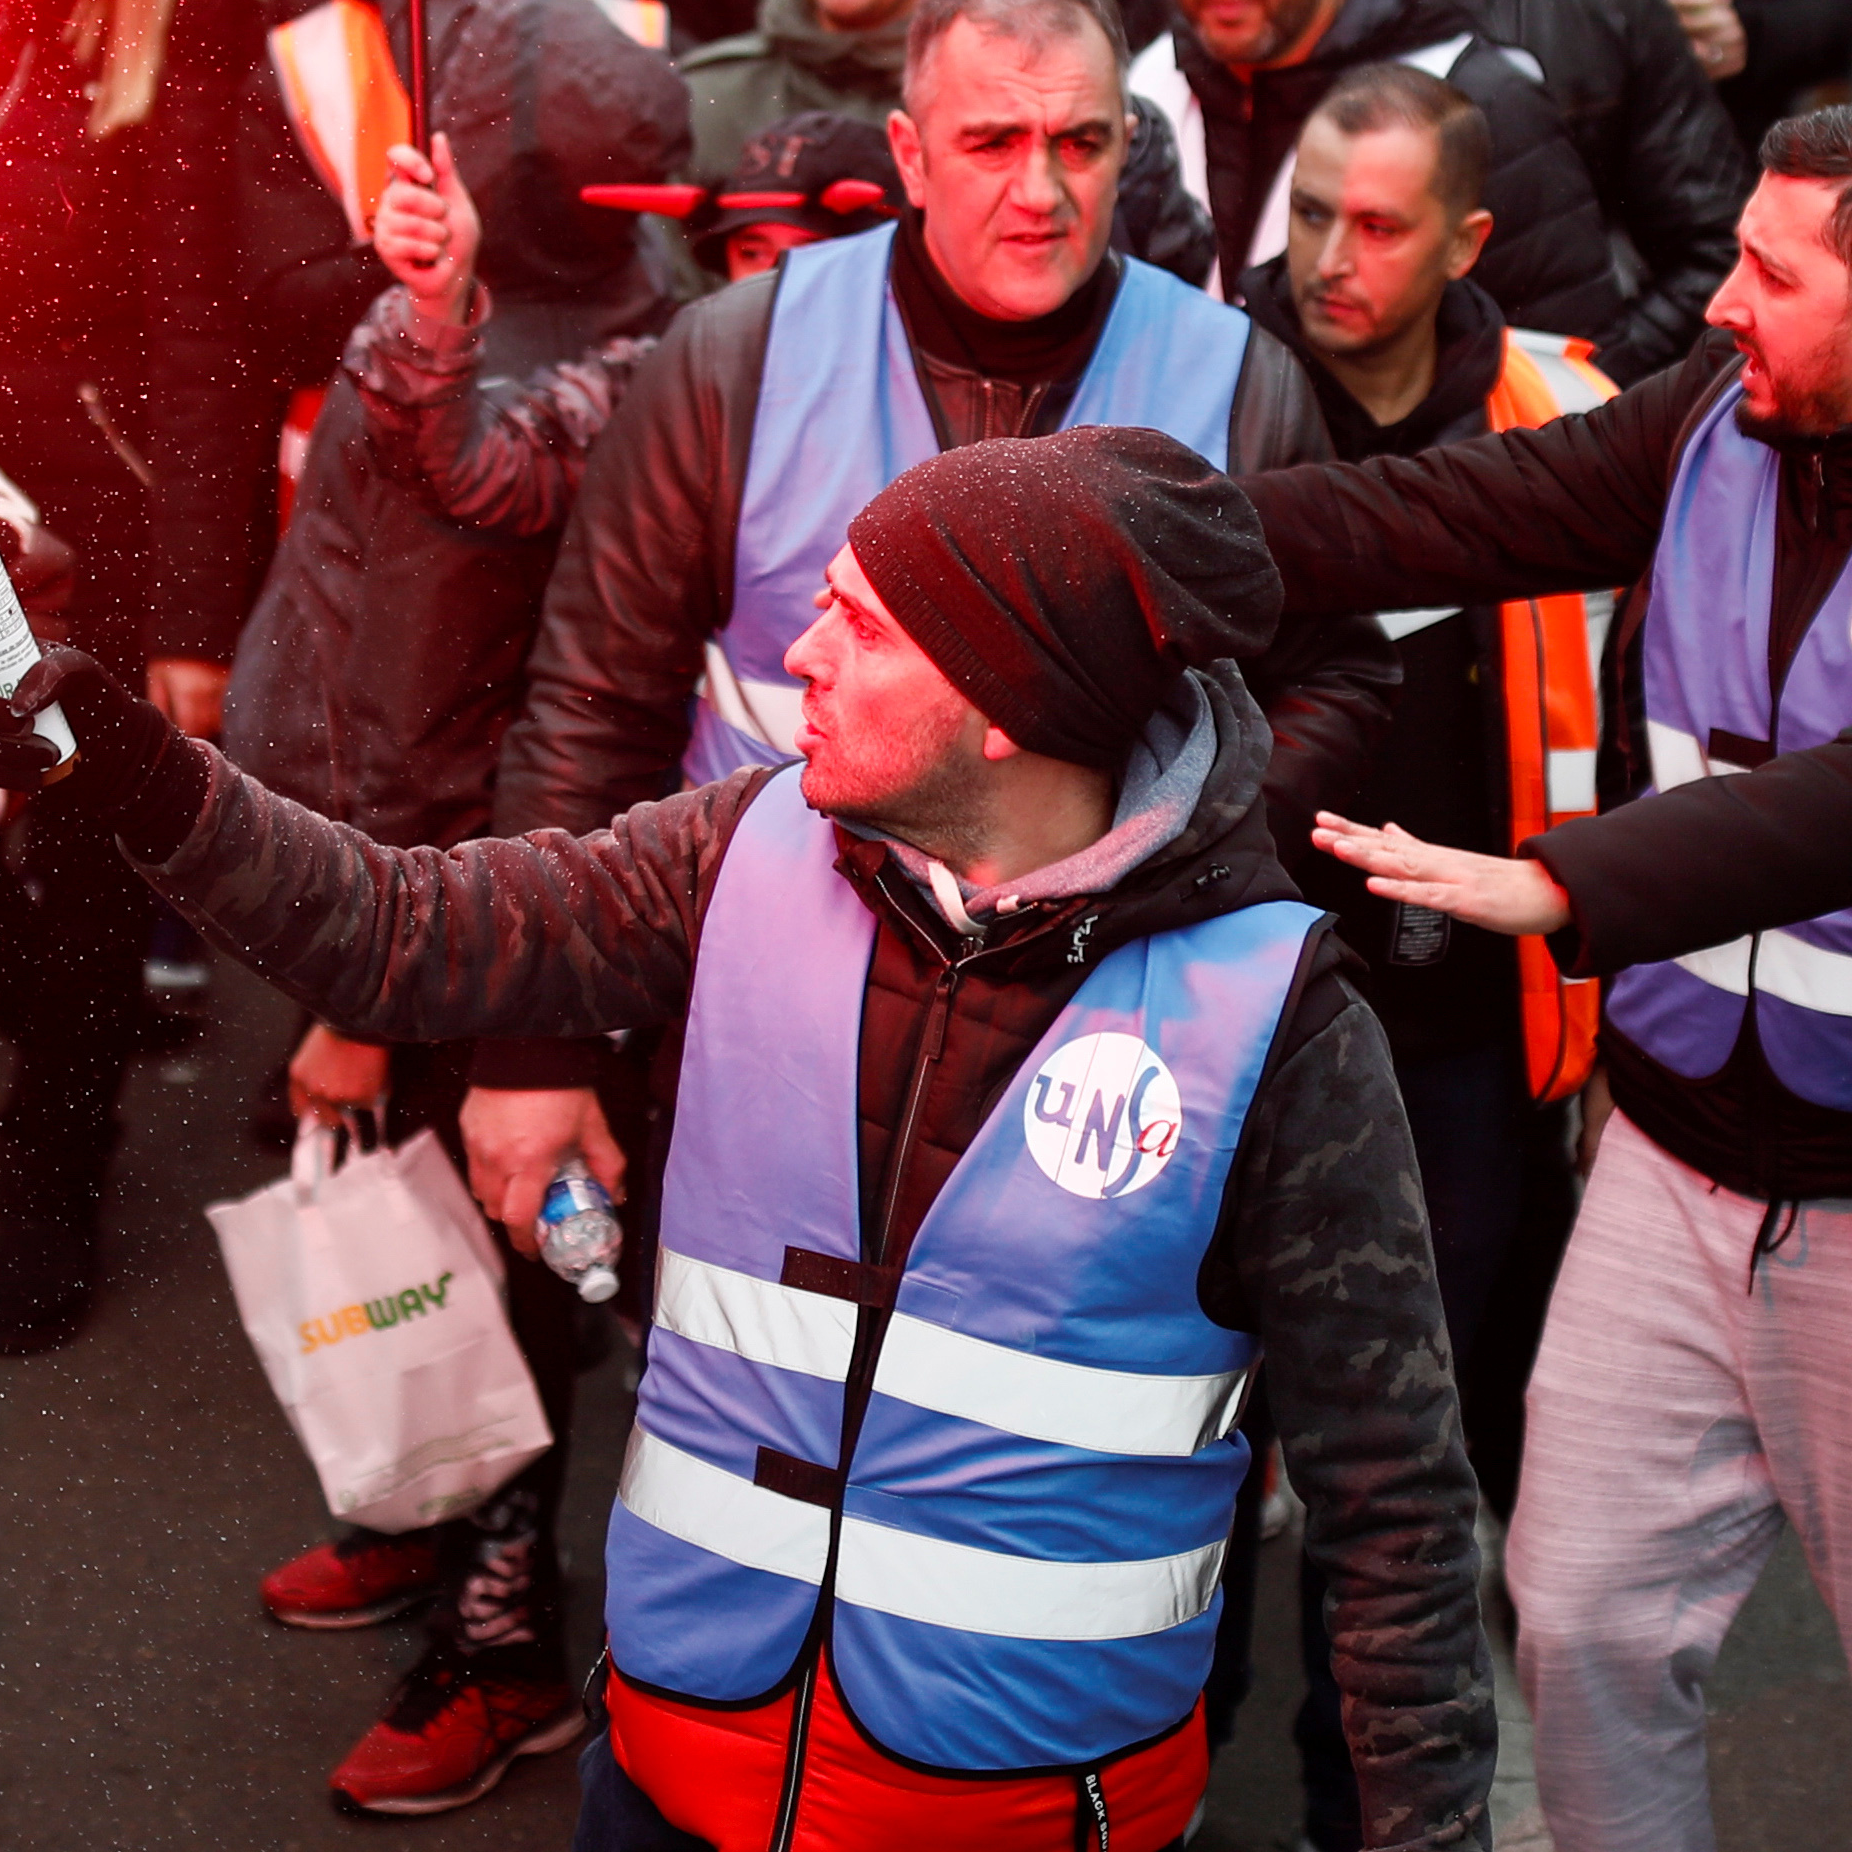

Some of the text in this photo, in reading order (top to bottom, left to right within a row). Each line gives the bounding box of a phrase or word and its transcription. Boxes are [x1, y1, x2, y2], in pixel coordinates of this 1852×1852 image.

[299, 1271, 454, 1354] SUBWAY
[1085, 1774, 1109, 1852] BLACK SQU
